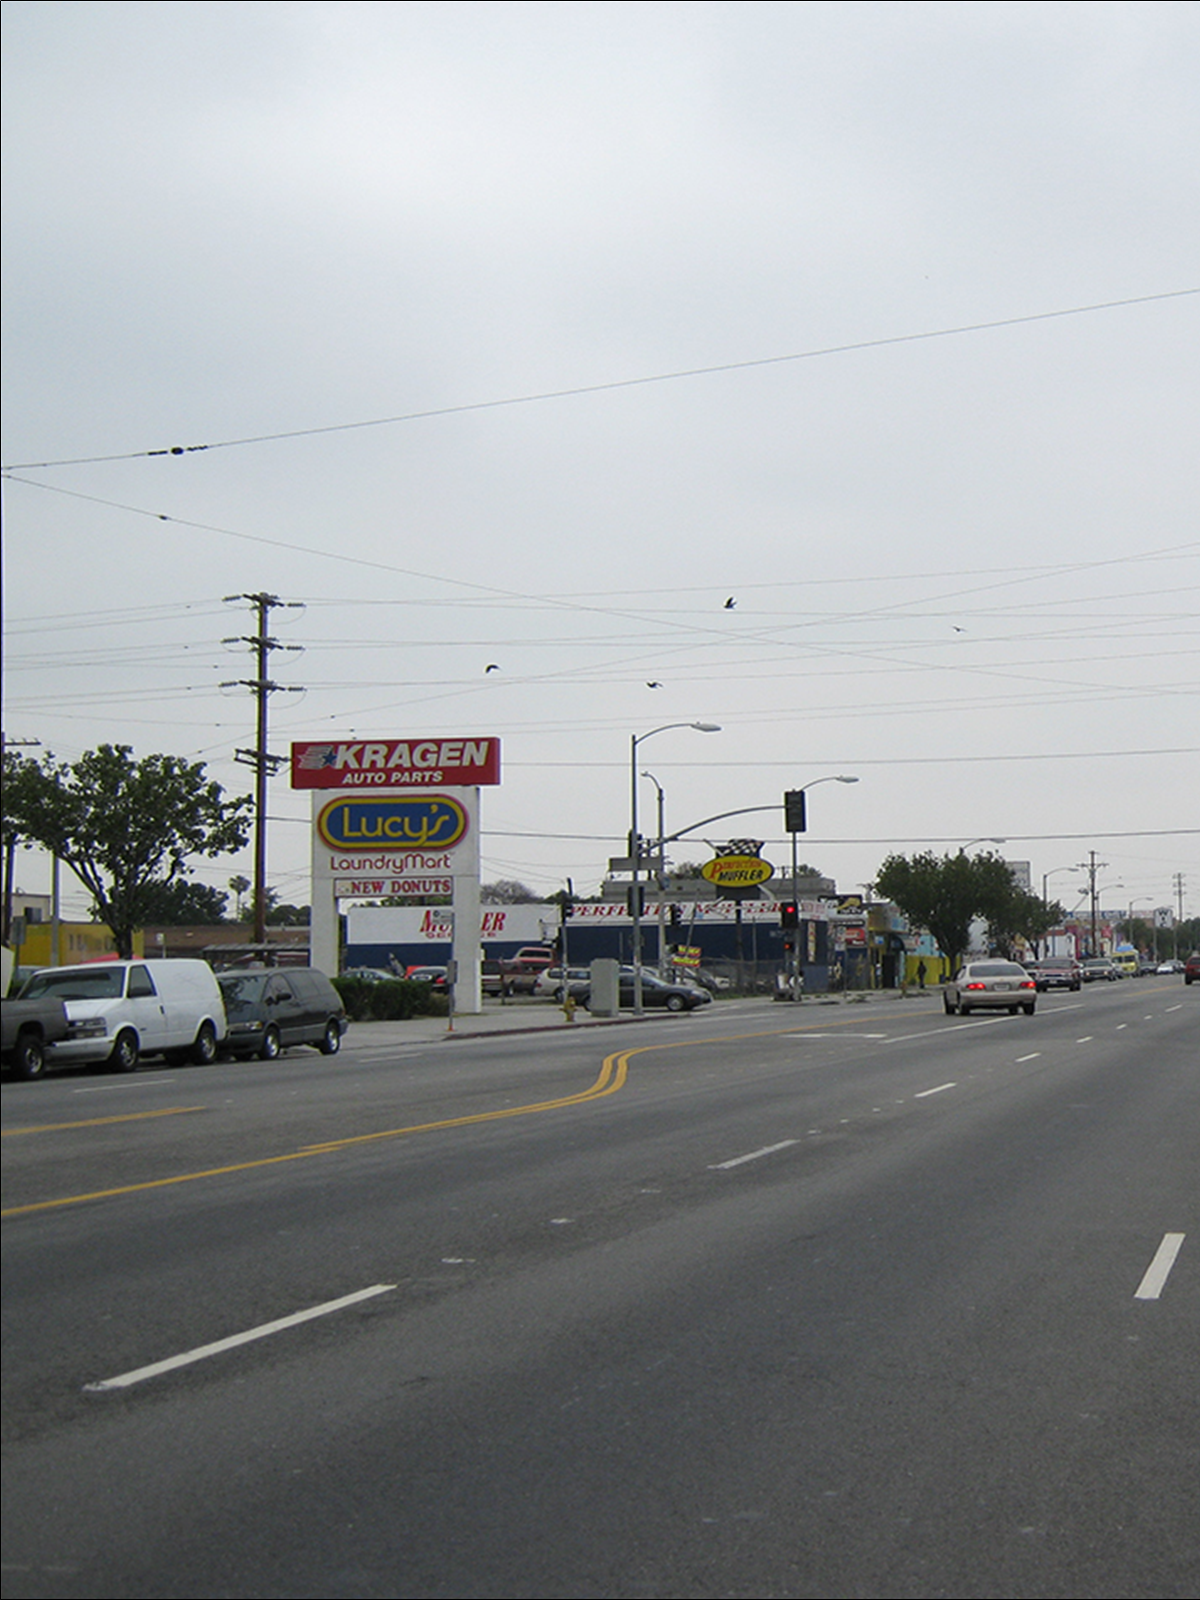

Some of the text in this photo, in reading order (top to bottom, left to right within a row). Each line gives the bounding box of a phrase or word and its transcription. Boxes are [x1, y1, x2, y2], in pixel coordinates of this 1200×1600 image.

[335, 741, 489, 770] KRAGEN
[342, 770, 444, 784] AUTO PARTS
[343, 804, 450, 847] Lucy's
[330, 853, 451, 874] LaundryMart
[718, 869, 764, 882] MUFFLER
[351, 879, 450, 894] NEW DONUTS
